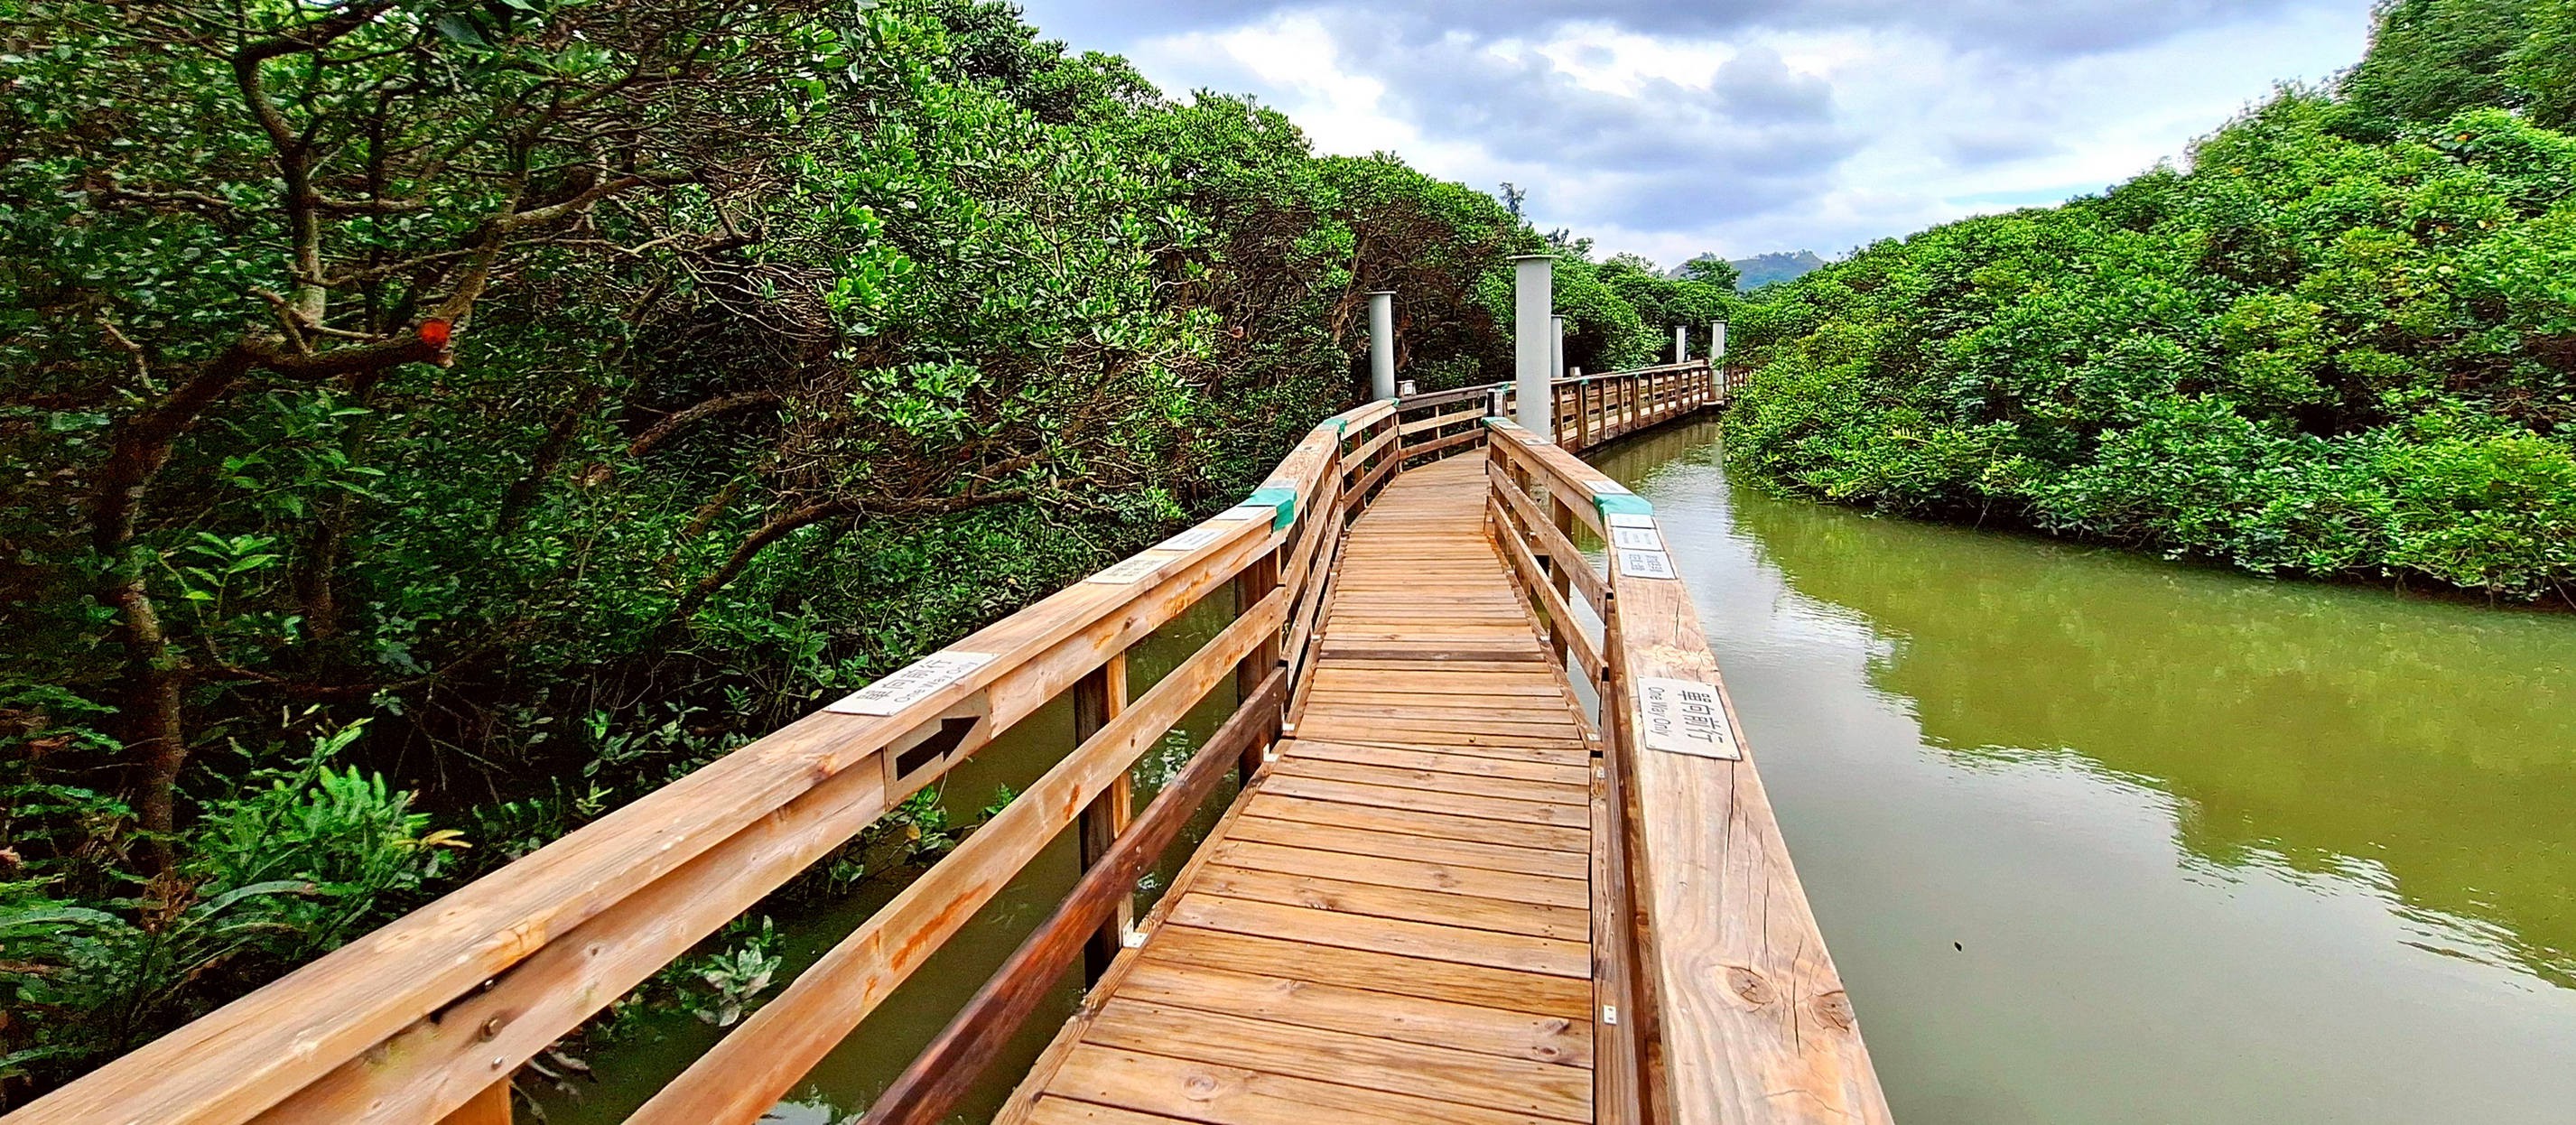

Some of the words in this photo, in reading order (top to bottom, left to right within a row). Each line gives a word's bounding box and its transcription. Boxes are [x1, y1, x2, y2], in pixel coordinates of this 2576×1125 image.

[857, 659, 953, 701] 單向前行
[894, 689, 926, 703] One
[920, 674, 953, 688] Way
[945, 661, 979, 674] Only
[1648, 686, 1665, 701] One
[1648, 702, 1669, 718] Way
[1676, 690, 1723, 743] 單向前行
[1651, 719, 1672, 737] Only
